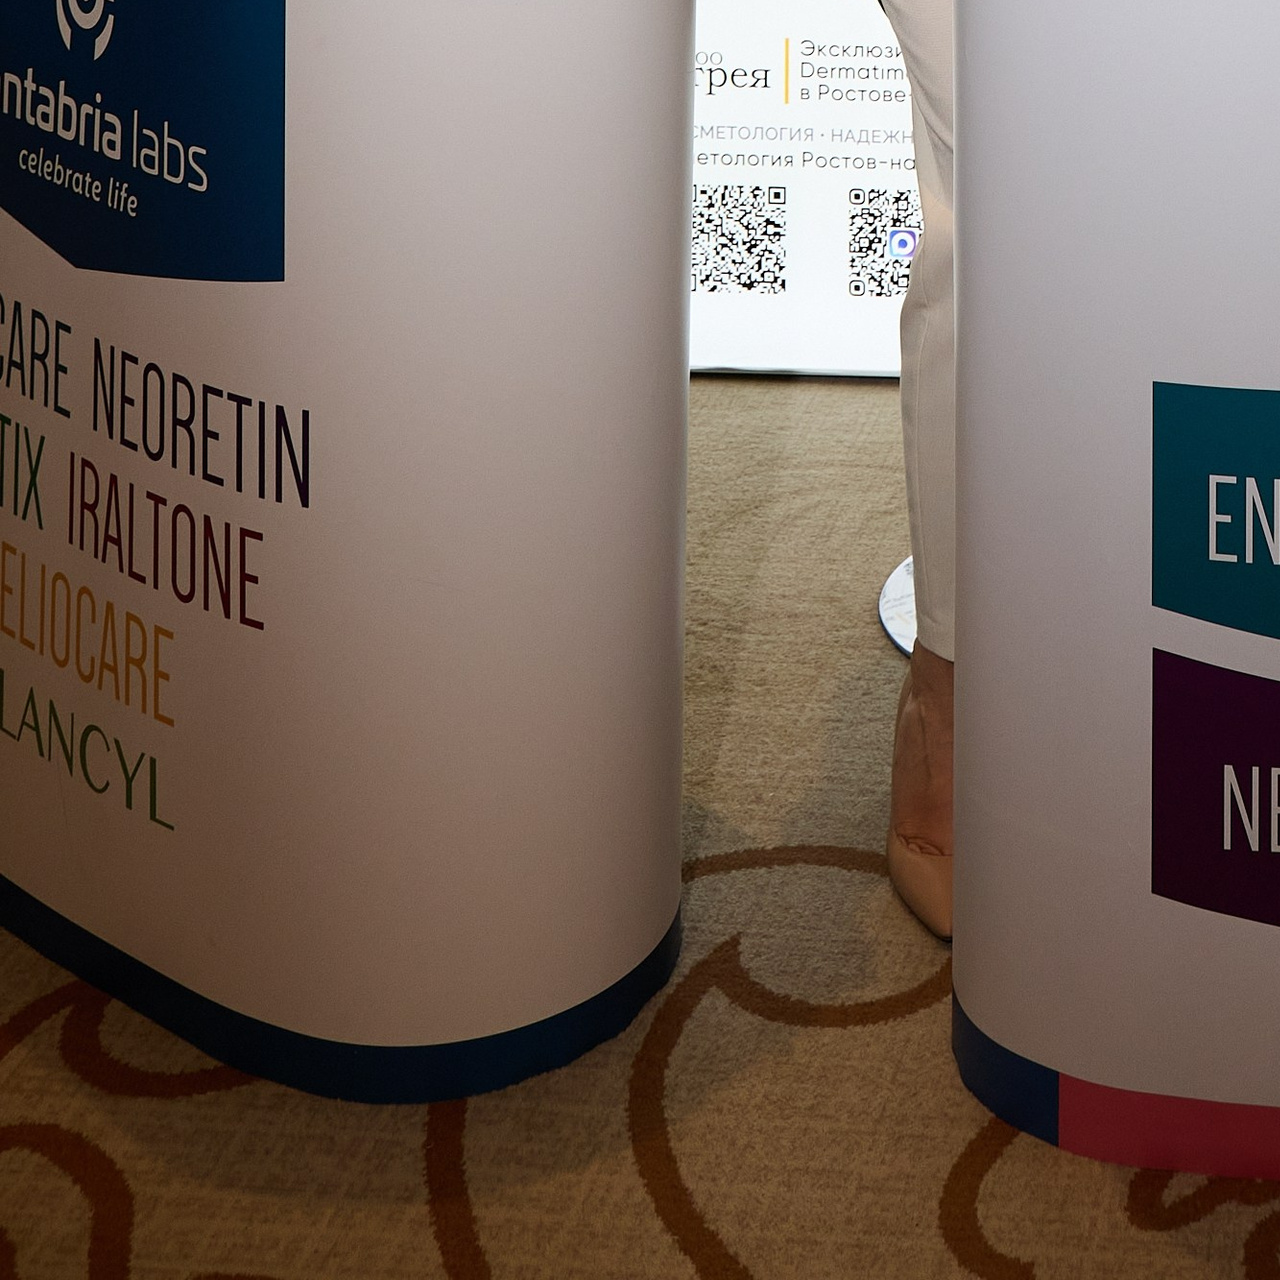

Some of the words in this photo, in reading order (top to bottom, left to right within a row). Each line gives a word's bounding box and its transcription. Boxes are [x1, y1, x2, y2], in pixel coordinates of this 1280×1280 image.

[19, 147, 101, 202] celebrate
[109, 177, 138, 218] life
[132, 109, 208, 193] labs
[92, 337, 310, 509] NEORETIN
[68, 451, 265, 631] IRALTONE
